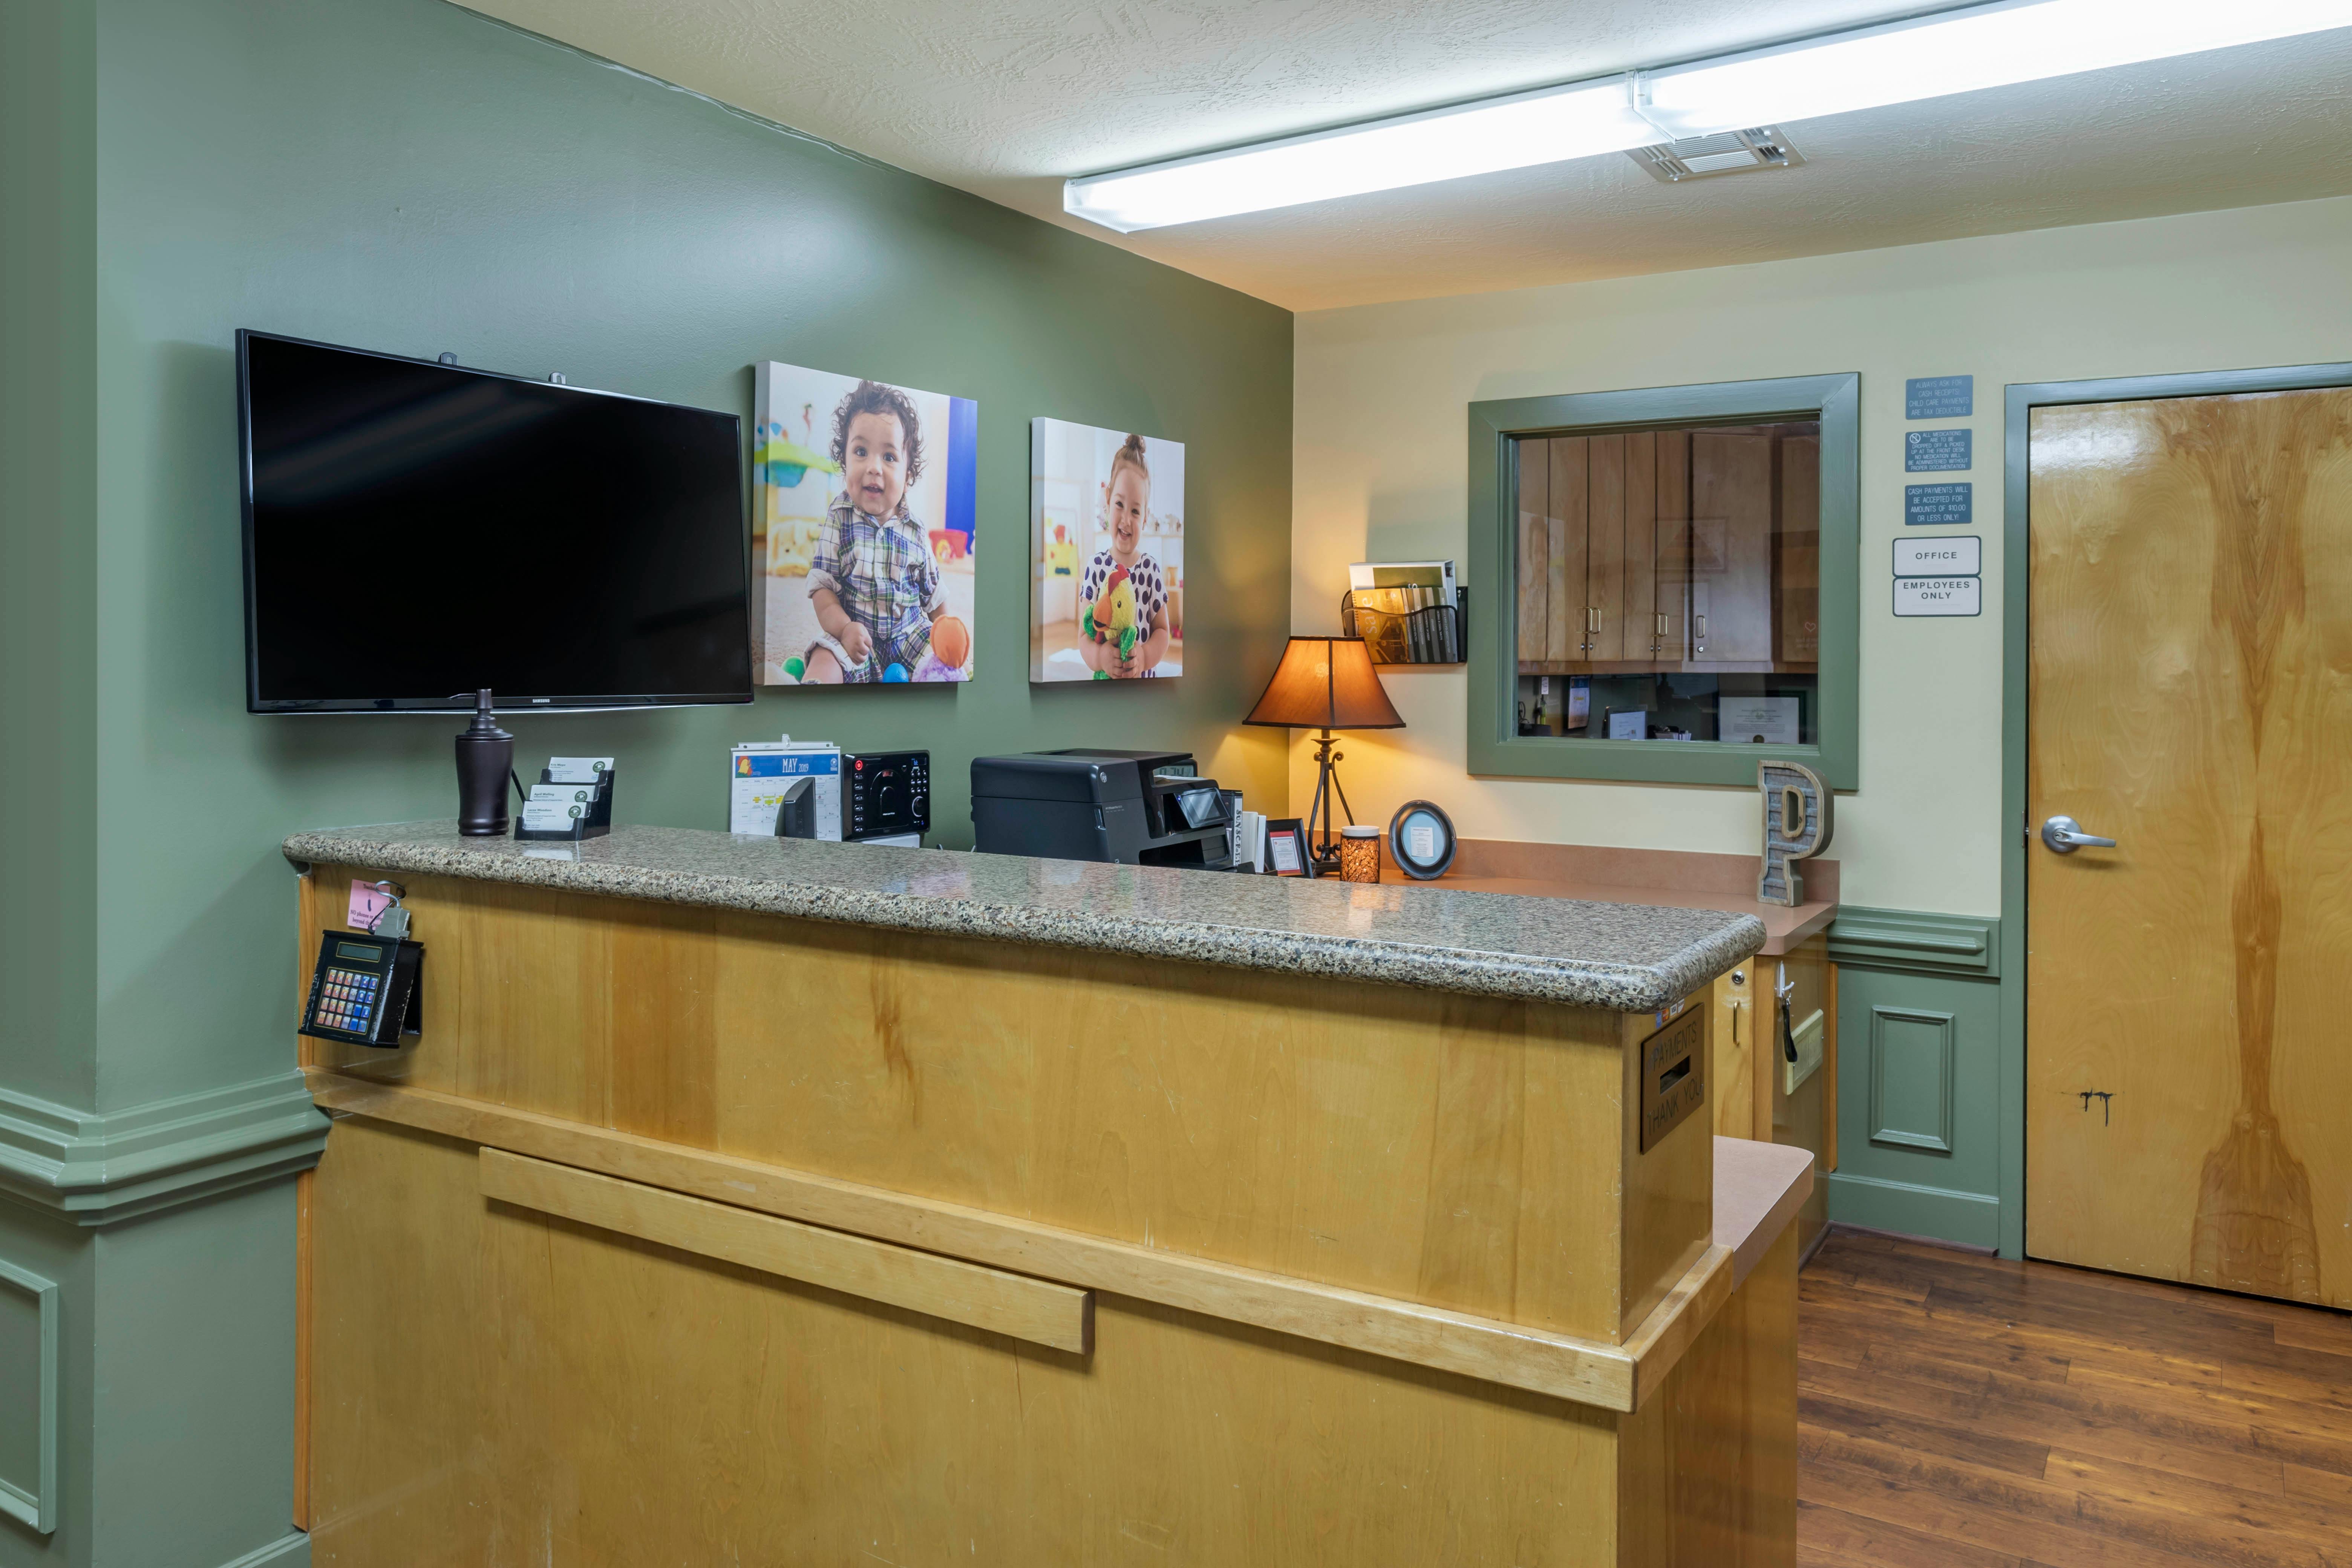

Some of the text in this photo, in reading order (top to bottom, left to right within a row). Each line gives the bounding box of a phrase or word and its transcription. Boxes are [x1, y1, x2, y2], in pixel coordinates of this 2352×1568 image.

[782, 758, 809, 773] MAY 2019
[1757, 760, 1832, 906] P
[1653, 1021, 1697, 1071] PAYMENTS
[1647, 1073, 1702, 1136] THANK YOU
